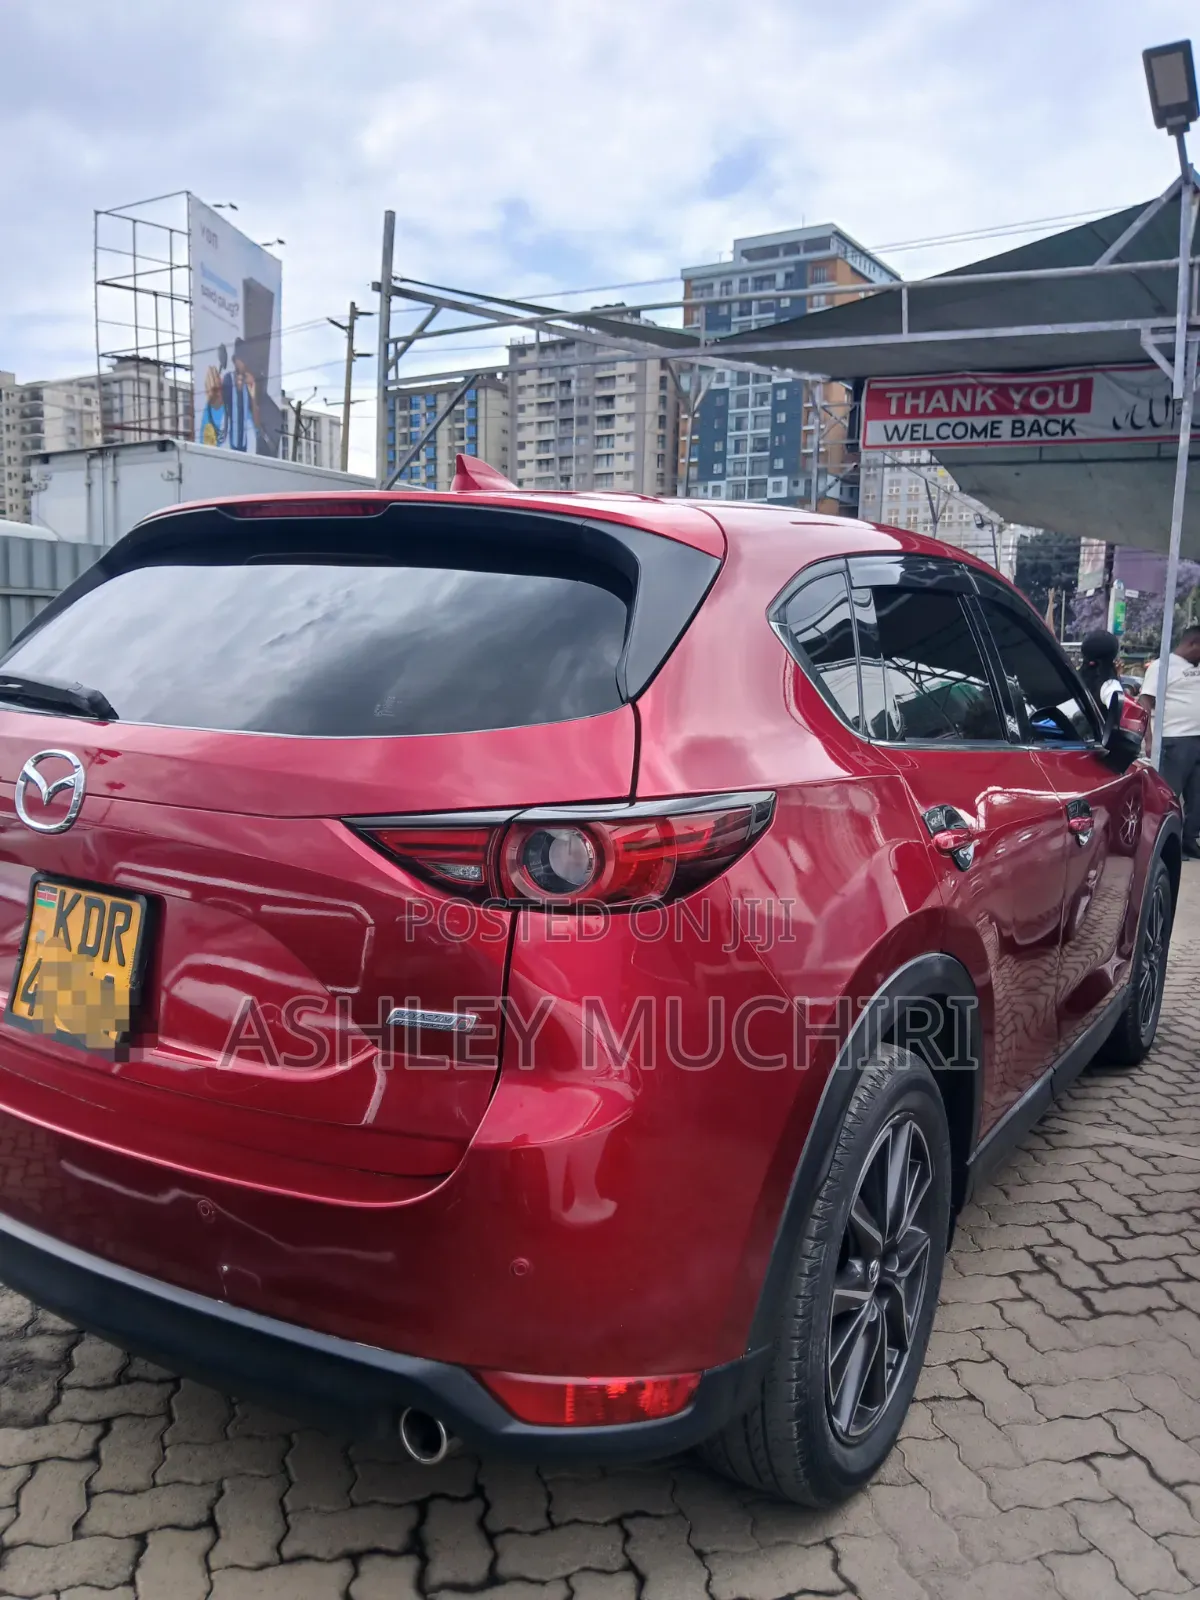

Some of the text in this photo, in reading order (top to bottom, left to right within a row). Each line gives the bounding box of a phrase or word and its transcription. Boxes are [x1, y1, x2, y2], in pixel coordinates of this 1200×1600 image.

[885, 383, 1080, 415] THANK YOU
[883, 418, 1077, 442] WELCOME BACK
[54, 889, 133, 967] KDR
[395, 1010, 454, 1024] SKYACTIV
